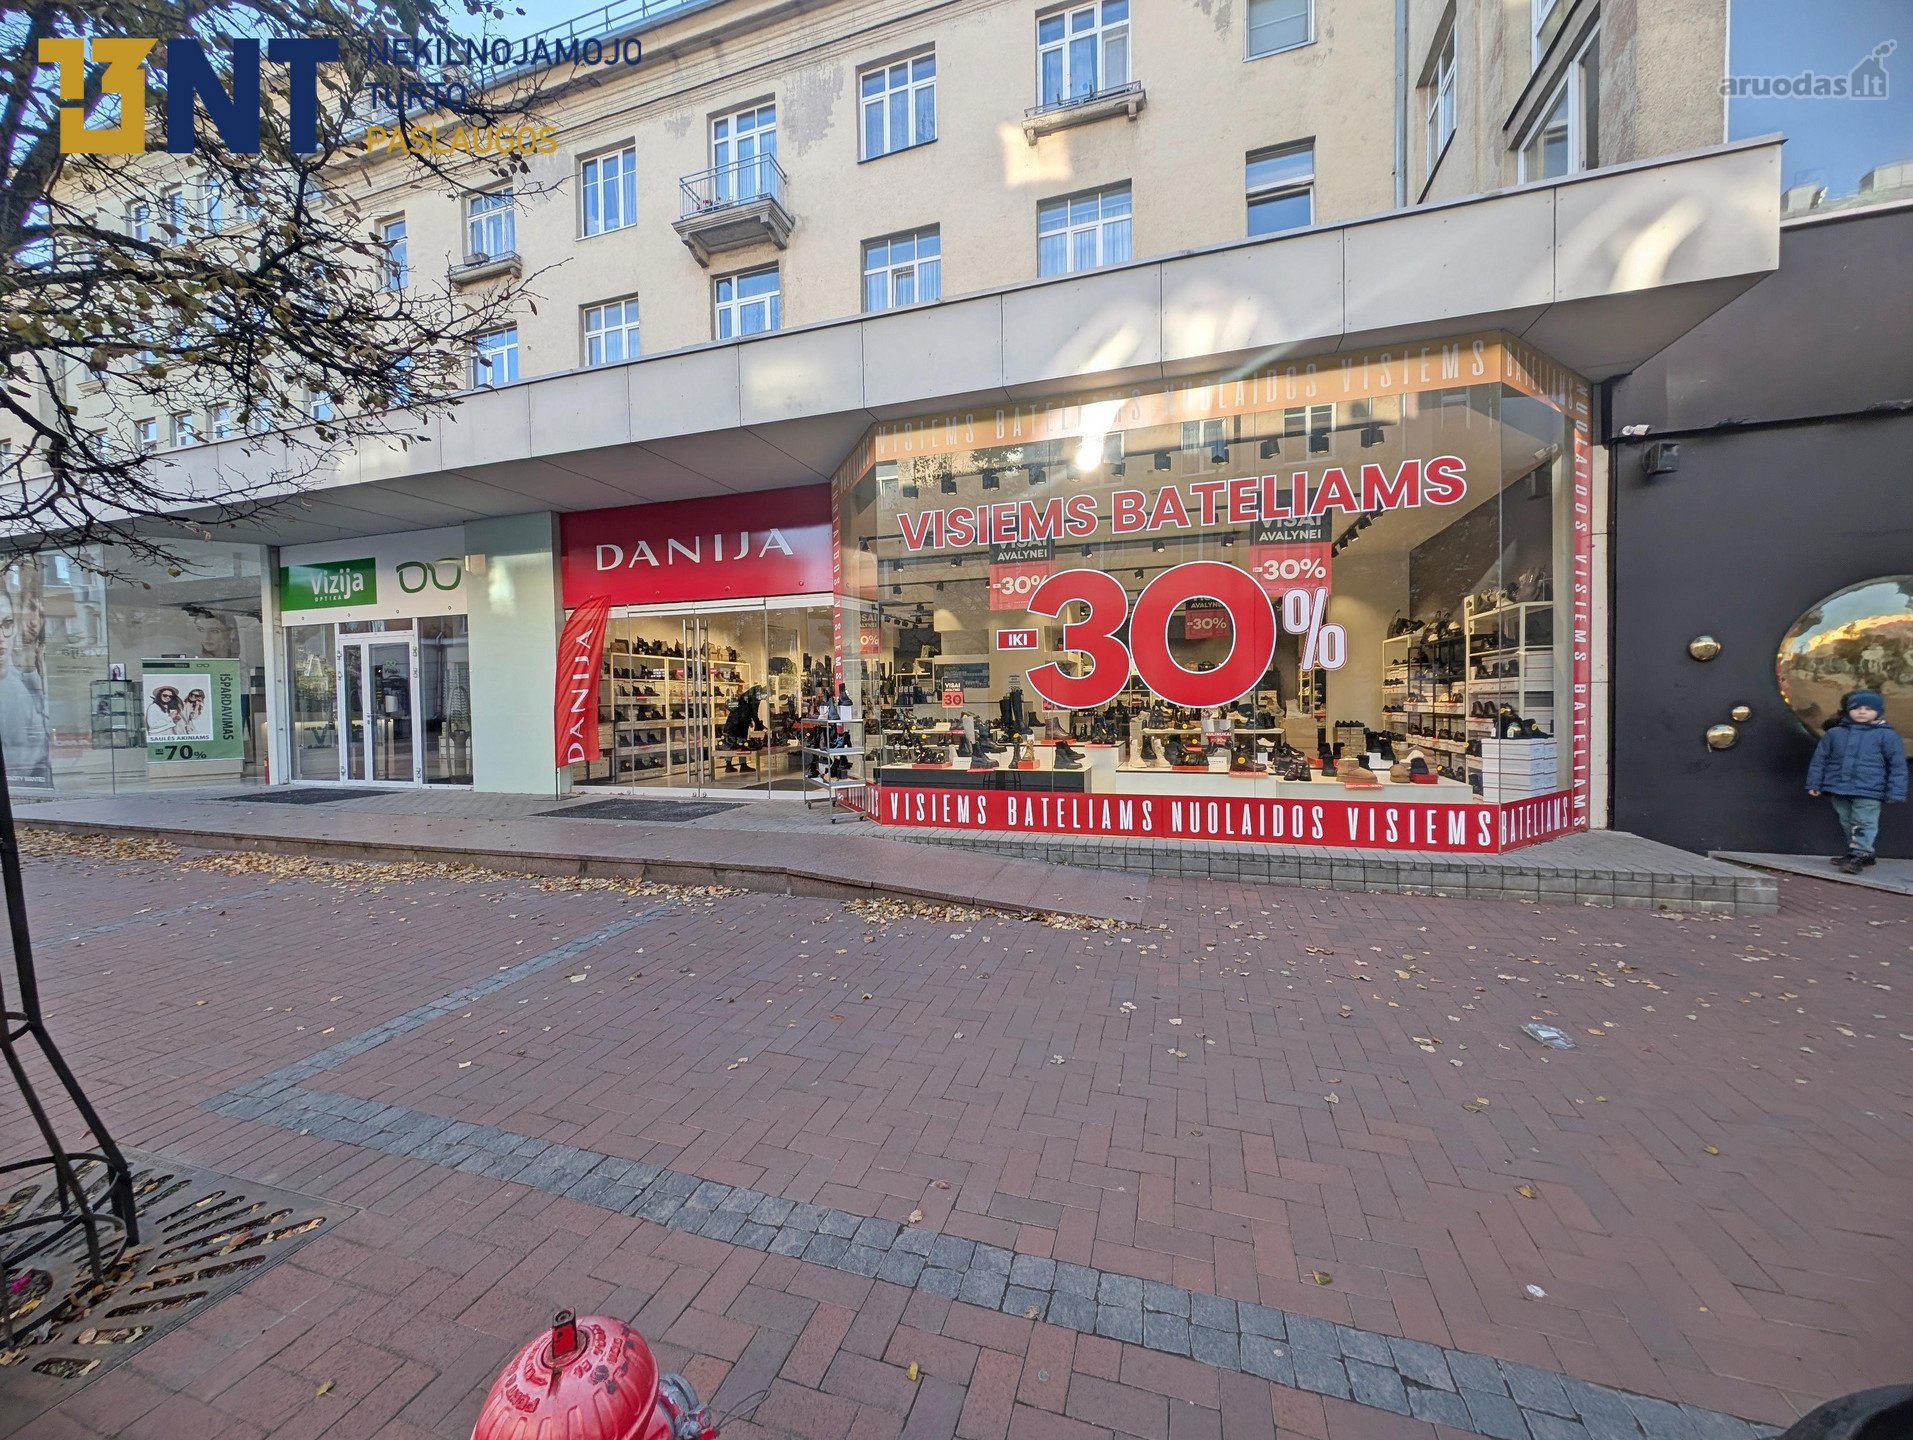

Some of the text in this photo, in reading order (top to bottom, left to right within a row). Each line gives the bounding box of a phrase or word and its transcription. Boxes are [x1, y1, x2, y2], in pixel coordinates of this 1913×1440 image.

[878, 413, 974, 455] VISIEMS
[1341, 339, 1485, 393] VISIEMS
[1506, 342, 1574, 410] BATELIAMS
[897, 455, 1467, 552] VISIEMS BATELIAMS
[596, 528, 794, 571] DANIJA
[997, 549, 1047, 561] AVALYNEI
[1259, 529, 1322, 542] AVALYNEI
[311, 568, 364, 600] Vizija
[1253, 558, 1327, 580] -30%
[1187, 617, 1227, 630] -30%
[1573, 383, 1589, 827] NUOLAIDOS VISIEMS BATELIAMS
[1007, 633, 1029, 646] IKI
[220, 673, 235, 740] IŠPARDAVIMAS
[567, 627, 595, 764] DANIJA
[890, 792, 987, 825] VISIEMS
[1008, 796, 1152, 831] BATELIAMS
[1171, 801, 1323, 840] NUOLAIDOS
[1347, 807, 1491, 846] VISIEMS
[1501, 796, 1569, 846] BATELIAMS
